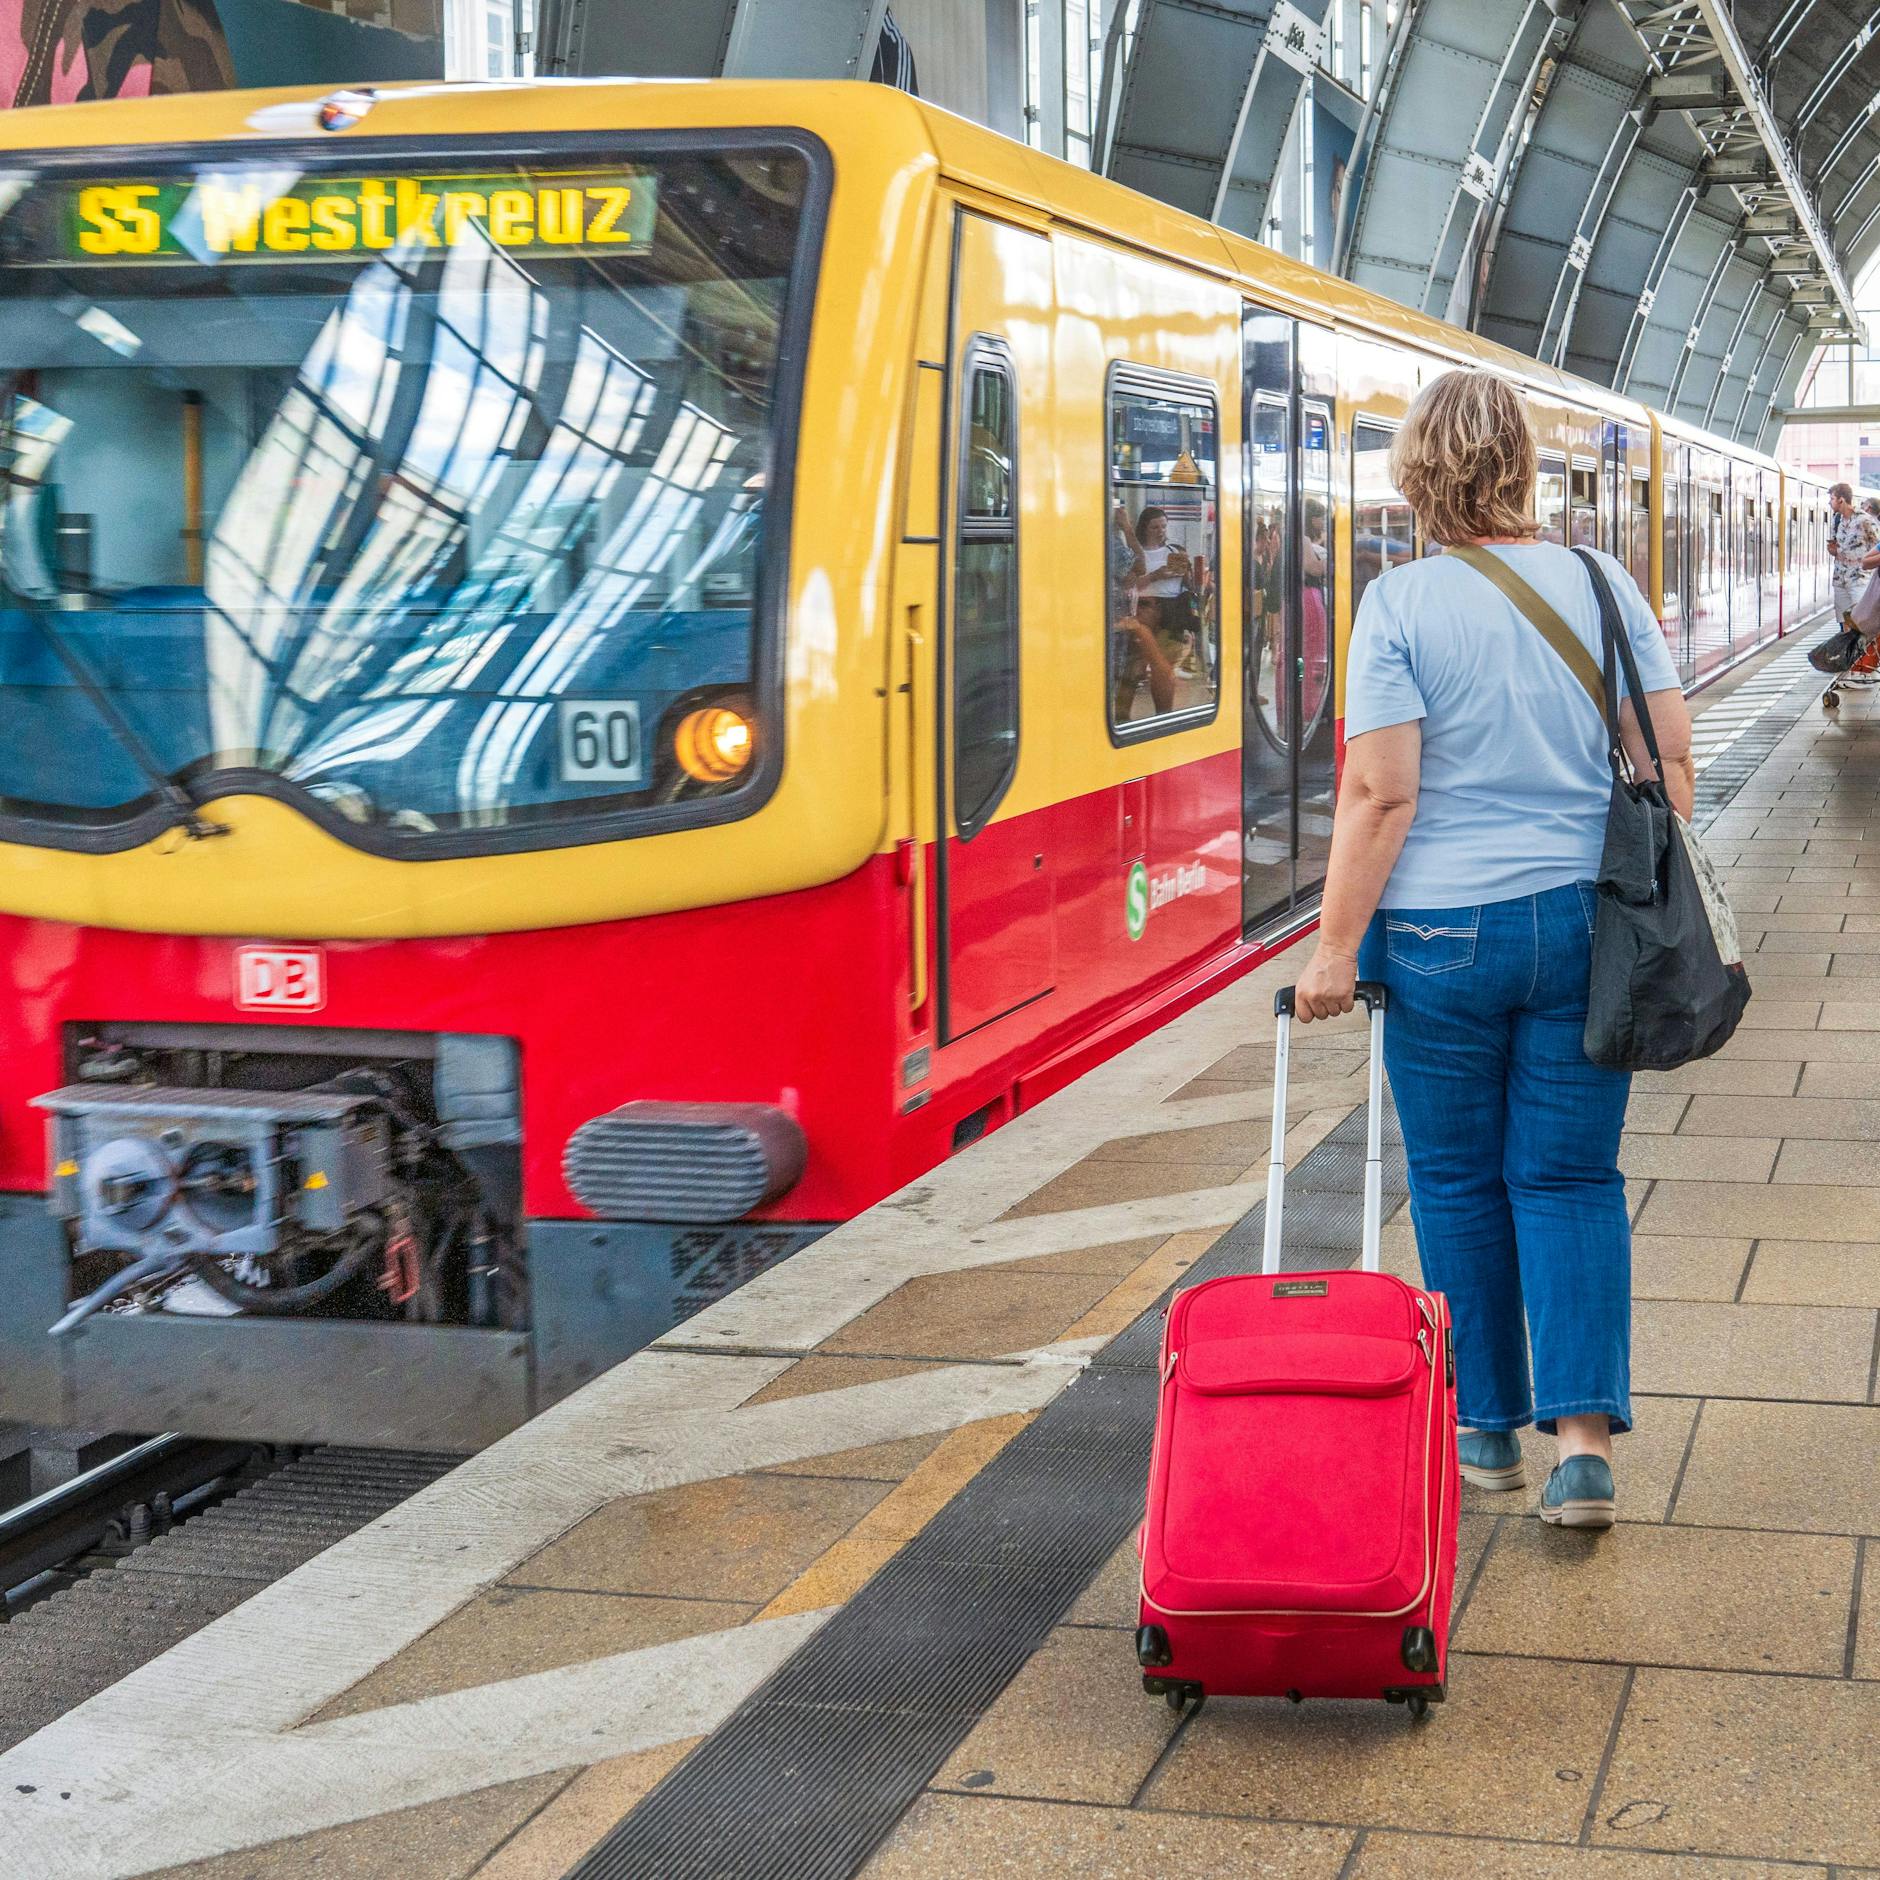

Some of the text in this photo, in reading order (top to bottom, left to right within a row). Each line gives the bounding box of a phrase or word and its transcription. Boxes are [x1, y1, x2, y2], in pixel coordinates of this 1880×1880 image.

[79, 177, 632, 254] S5 Westkreuz
[573, 710, 632, 769] 60
[1129, 869, 1147, 933] S
[1177, 858, 1207, 898] Berlin
[247, 957, 309, 1000] DB
